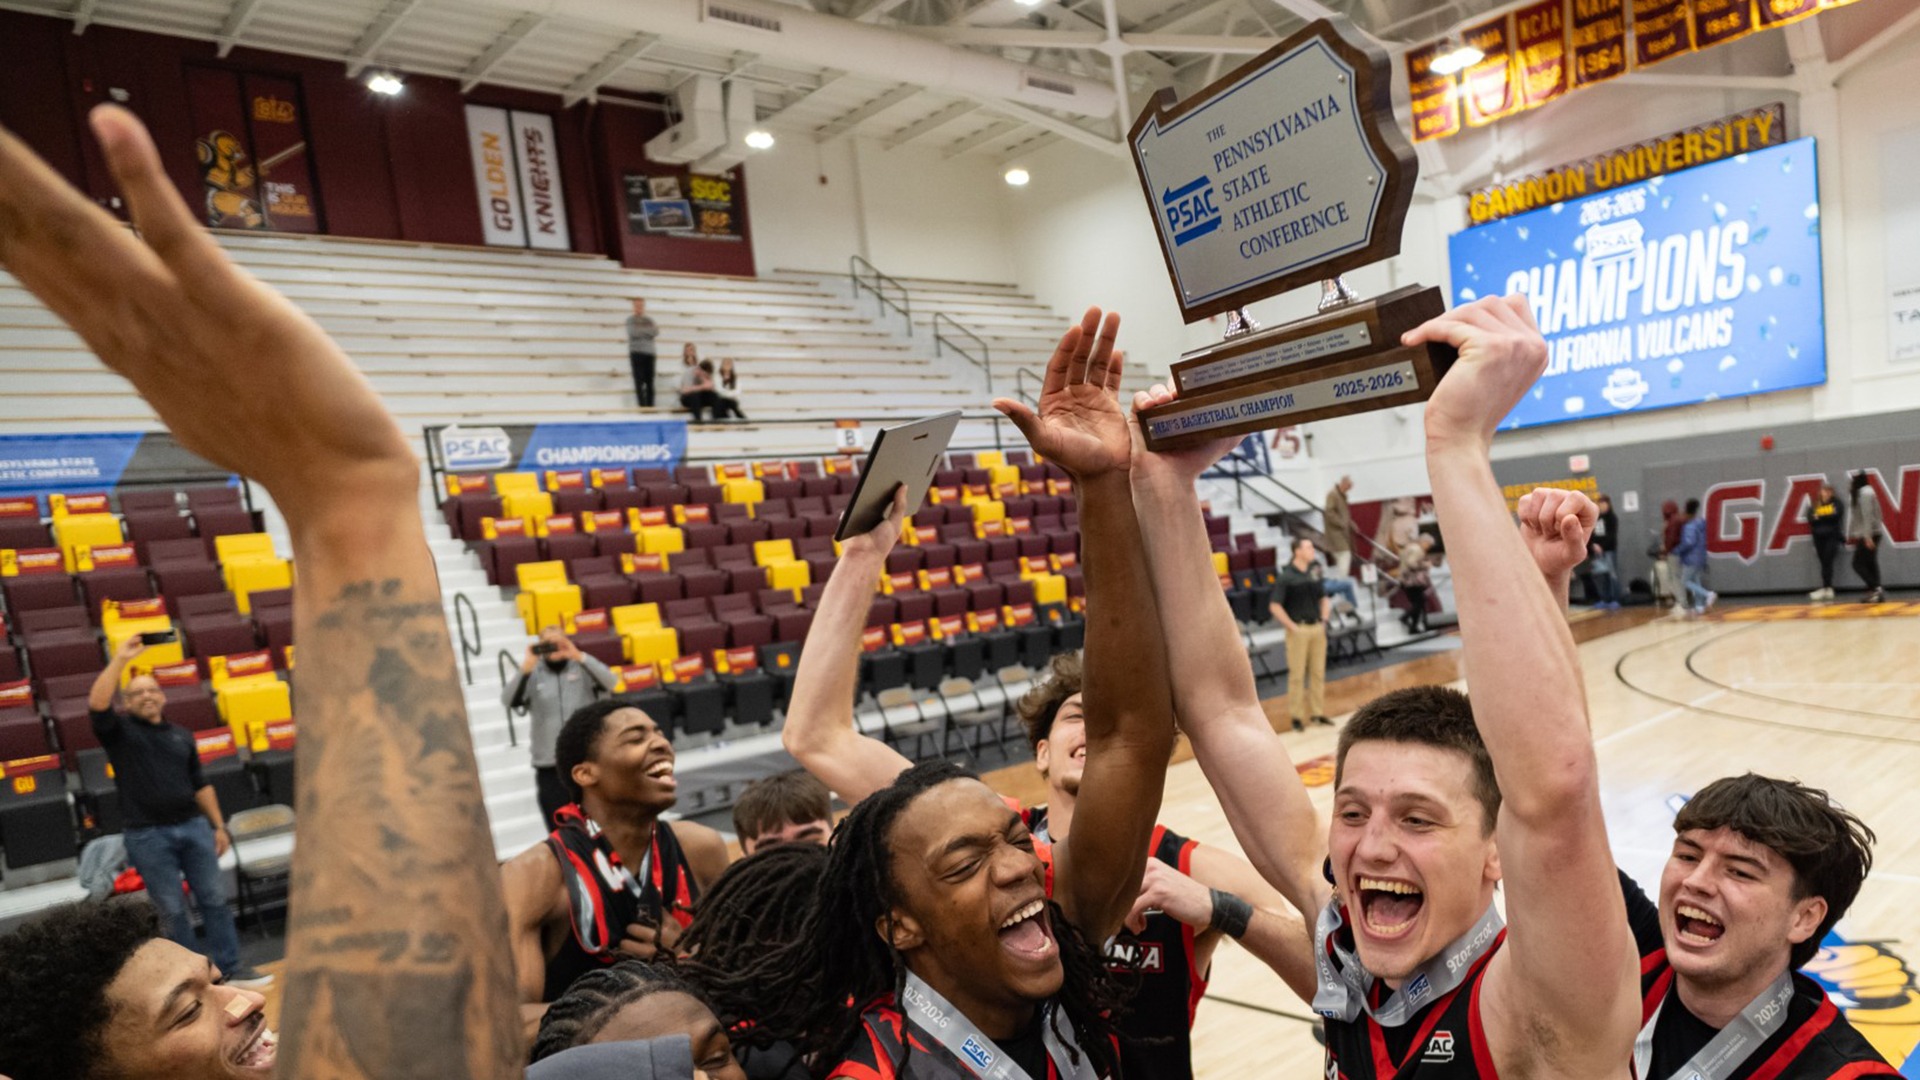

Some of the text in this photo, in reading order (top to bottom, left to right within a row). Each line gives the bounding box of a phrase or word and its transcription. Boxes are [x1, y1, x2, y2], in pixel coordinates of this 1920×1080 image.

[1519, 6, 1561, 41] NCAA
[1578, 44, 1621, 75] 1964
[1206, 124, 1227, 143] THE
[1213, 94, 1342, 173] PENNSYLVANIA
[481, 131, 513, 232] GOLDEN
[524, 126, 556, 234] KNIGHTS
[1222, 164, 1271, 202] STATE
[1470, 111, 1776, 222] GANNON UNIVERSITY
[1166, 187, 1220, 232] PSAC
[1233, 182, 1311, 231] ATHLETIC
[1239, 201, 1349, 259] CONFERENCE
[1637, 307, 1735, 361] VULCANS
[1152, 371, 1404, 435] MEN'S BASKETBALL CHAMPION 2025-2026
[445, 439, 505, 456] PSAC
[536, 443, 671, 466] CHAMPIONSHIPS
[845, 430, 856, 446] B
[29, 467, 99, 478] CONFERENCE
[60, 457, 95, 467] STATE
[1446, 921, 1493, 974] 2025-2026
[965, 1038, 993, 1066] PSAC
